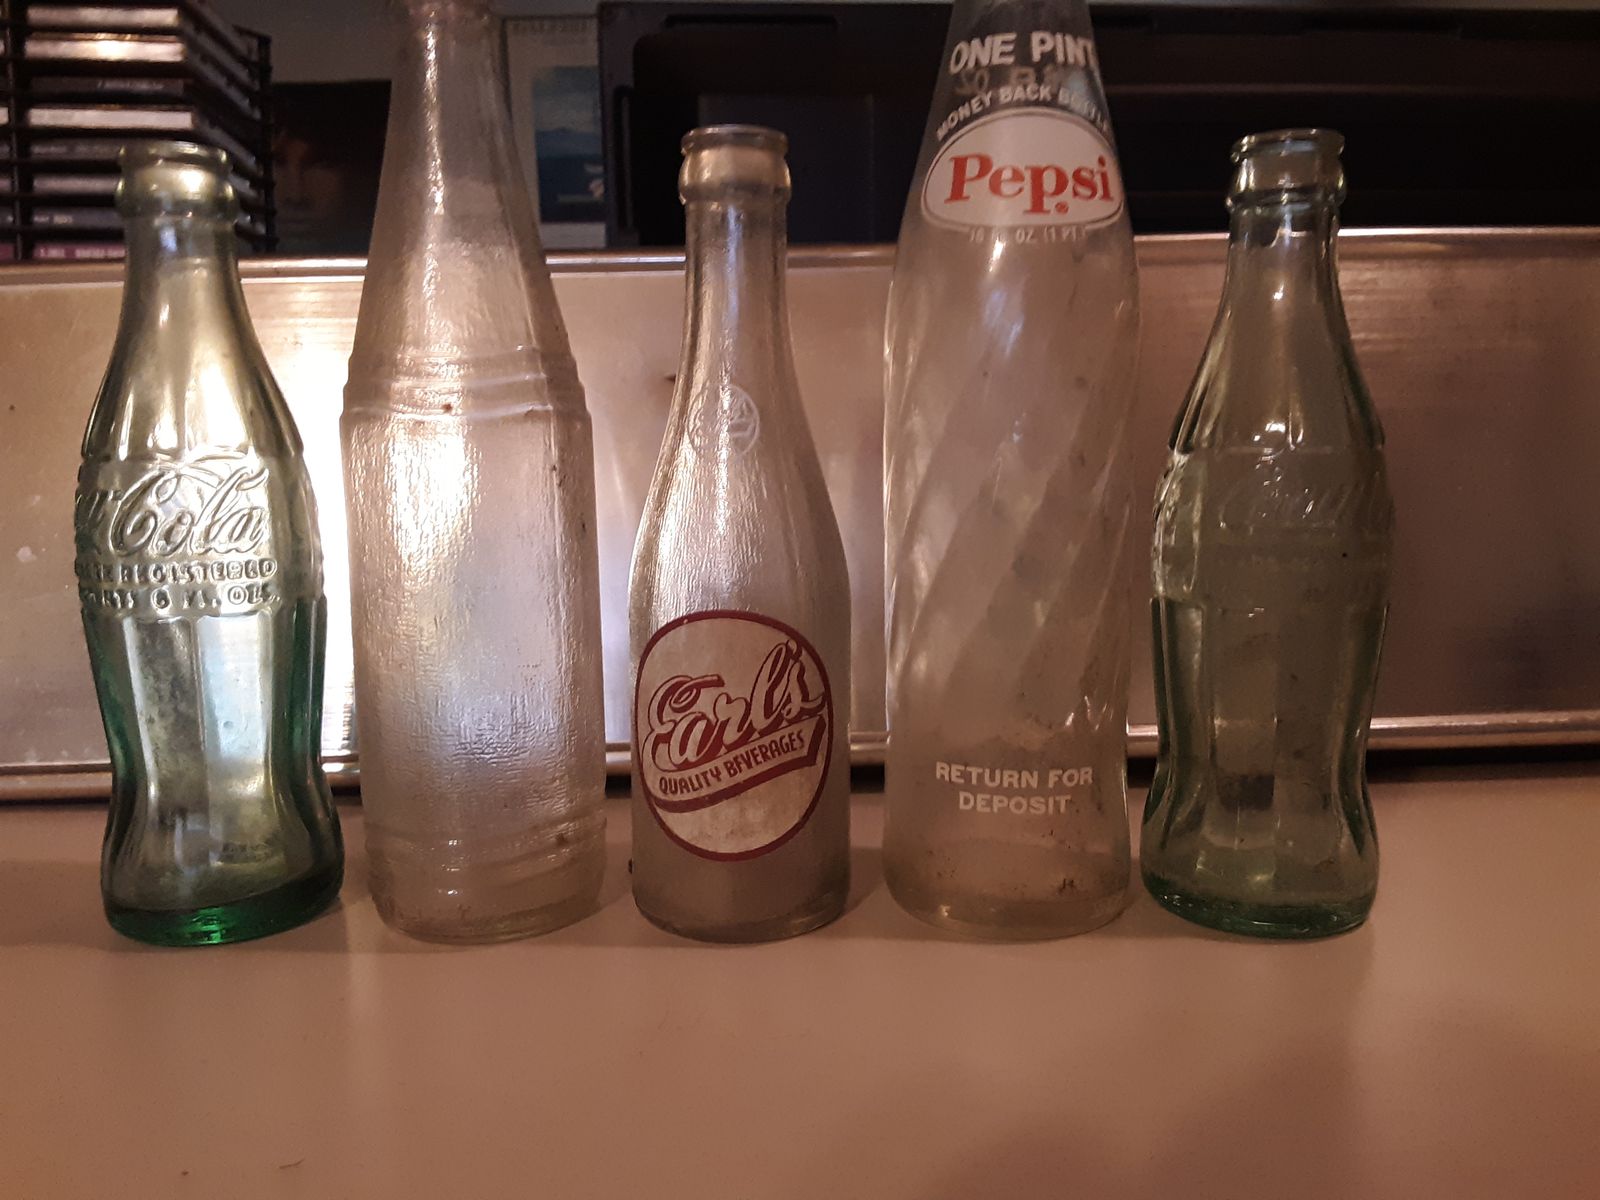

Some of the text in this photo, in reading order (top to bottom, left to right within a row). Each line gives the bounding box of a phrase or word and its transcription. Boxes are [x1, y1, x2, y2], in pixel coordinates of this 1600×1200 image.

[950, 31, 1097, 74] ONE PINT
[936, 91, 992, 141] MONEY
[1000, 84, 1051, 104] BACK
[944, 152, 1115, 215] Pepsi
[109, 450, 270, 557] Cola
[659, 729, 806, 796] QUALITY BEVERAGES
[936, 761, 1093, 789] RETURN FOR
[959, 791, 1072, 815] DEPOSIT
